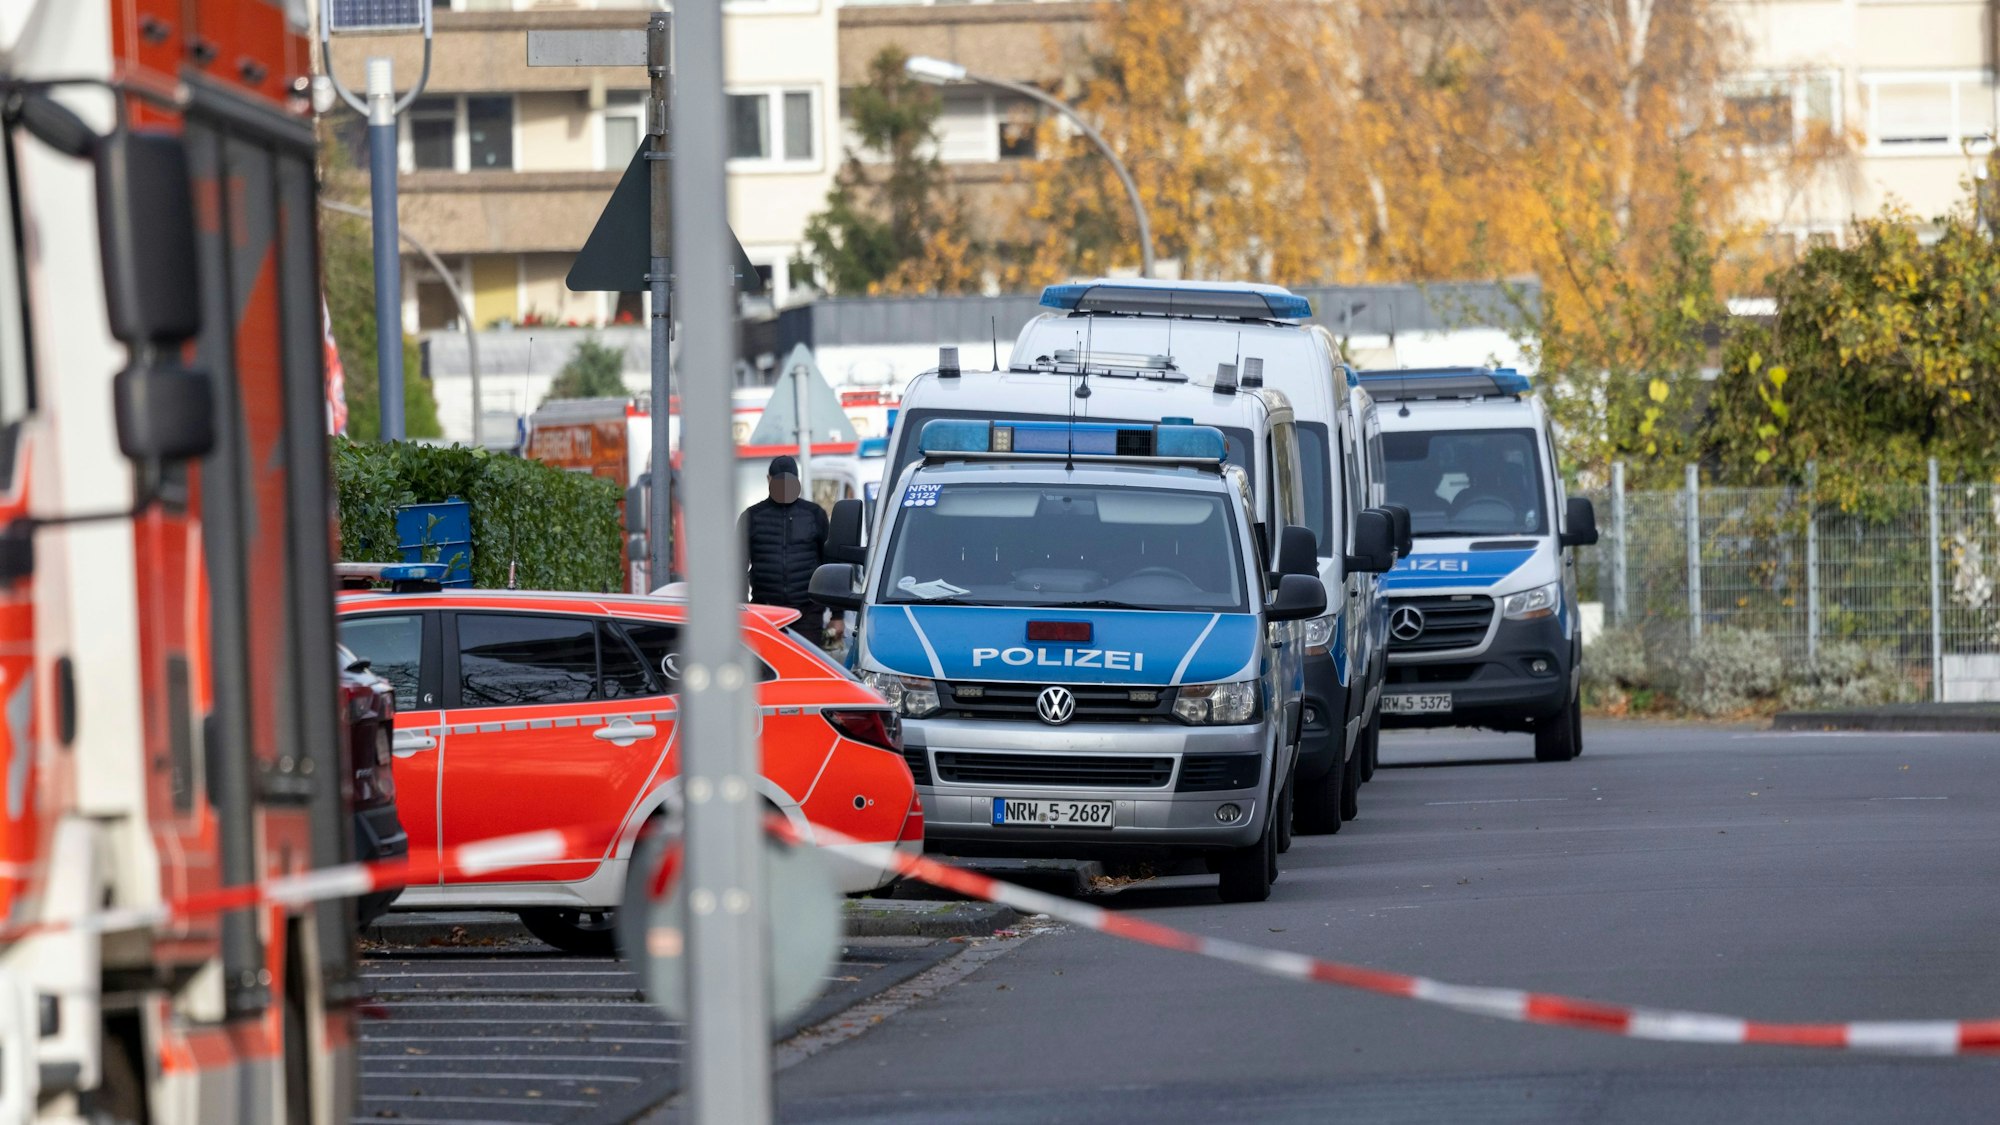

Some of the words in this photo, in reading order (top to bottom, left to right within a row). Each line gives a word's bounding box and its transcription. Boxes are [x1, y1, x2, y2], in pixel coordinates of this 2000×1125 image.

[908, 484, 941, 492] NRW
[1391, 559, 1468, 571] LIZEI
[973, 647, 1143, 672] POLIZEI
[1380, 695, 1399, 710] RW
[1005, 801, 1038, 821] NRW
